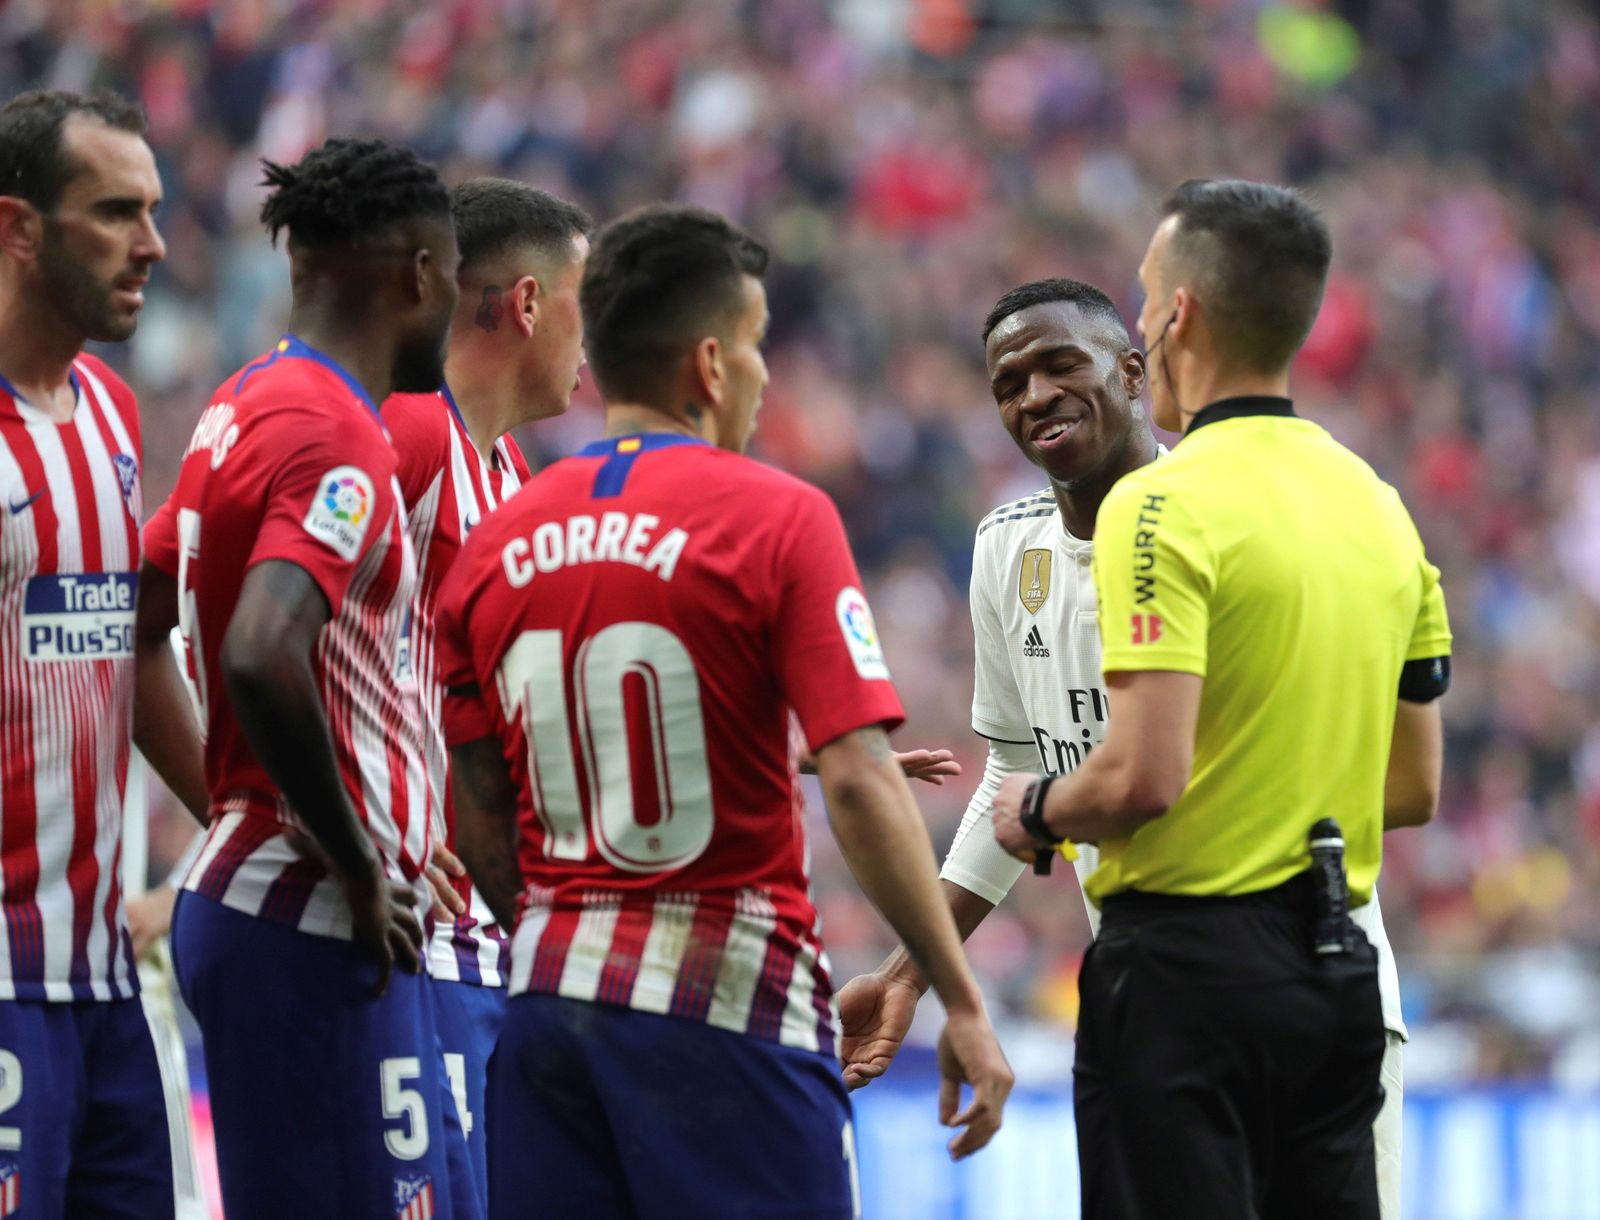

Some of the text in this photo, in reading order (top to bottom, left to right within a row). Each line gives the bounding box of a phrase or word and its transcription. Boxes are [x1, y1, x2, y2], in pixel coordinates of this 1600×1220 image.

[501, 511, 689, 588] CORREA
[58, 574, 130, 611] Trade
[1023, 644, 1050, 658] adidas
[495, 620, 715, 873] 10
[1032, 727, 1104, 777] Emi
[380, 1057, 430, 1161] 5
